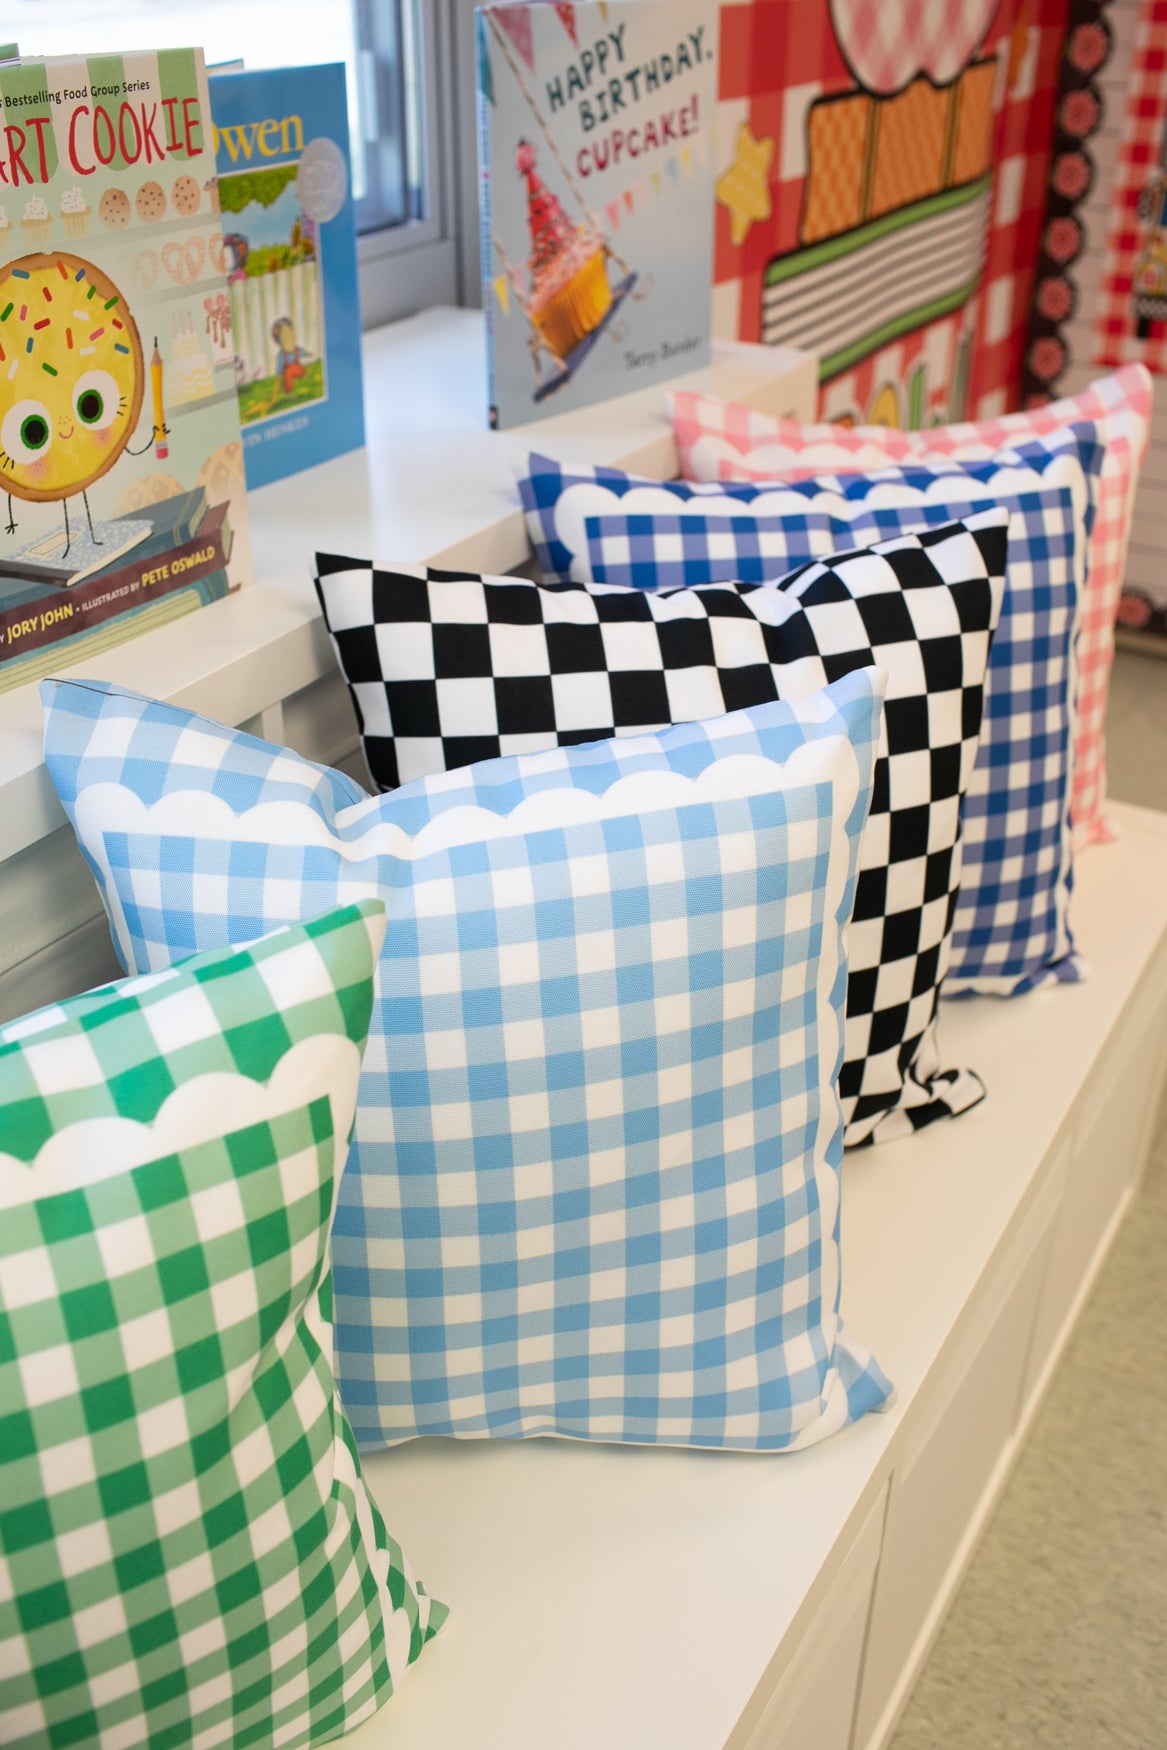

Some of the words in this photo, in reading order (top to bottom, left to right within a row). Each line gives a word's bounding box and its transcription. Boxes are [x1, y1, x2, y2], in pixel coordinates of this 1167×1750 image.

[5, 90, 61, 107] Bestselling
[64, 85, 88, 100] Food
[90, 84, 120, 97] Group
[122, 80, 150, 93] Series
[546, 22, 626, 112] HAPPY
[68, 97, 203, 176] COOKIE
[576, 93, 700, 177] CUPCAKE!
[7, 616, 38, 644] JORY
[40, 603, 73, 631] JOHN
[81, 588, 129, 611] ILLUSTRATED
[130, 581, 140, 593] BY
[141, 565, 169, 587] PETE
[171, 546, 216, 575] OSWALD
